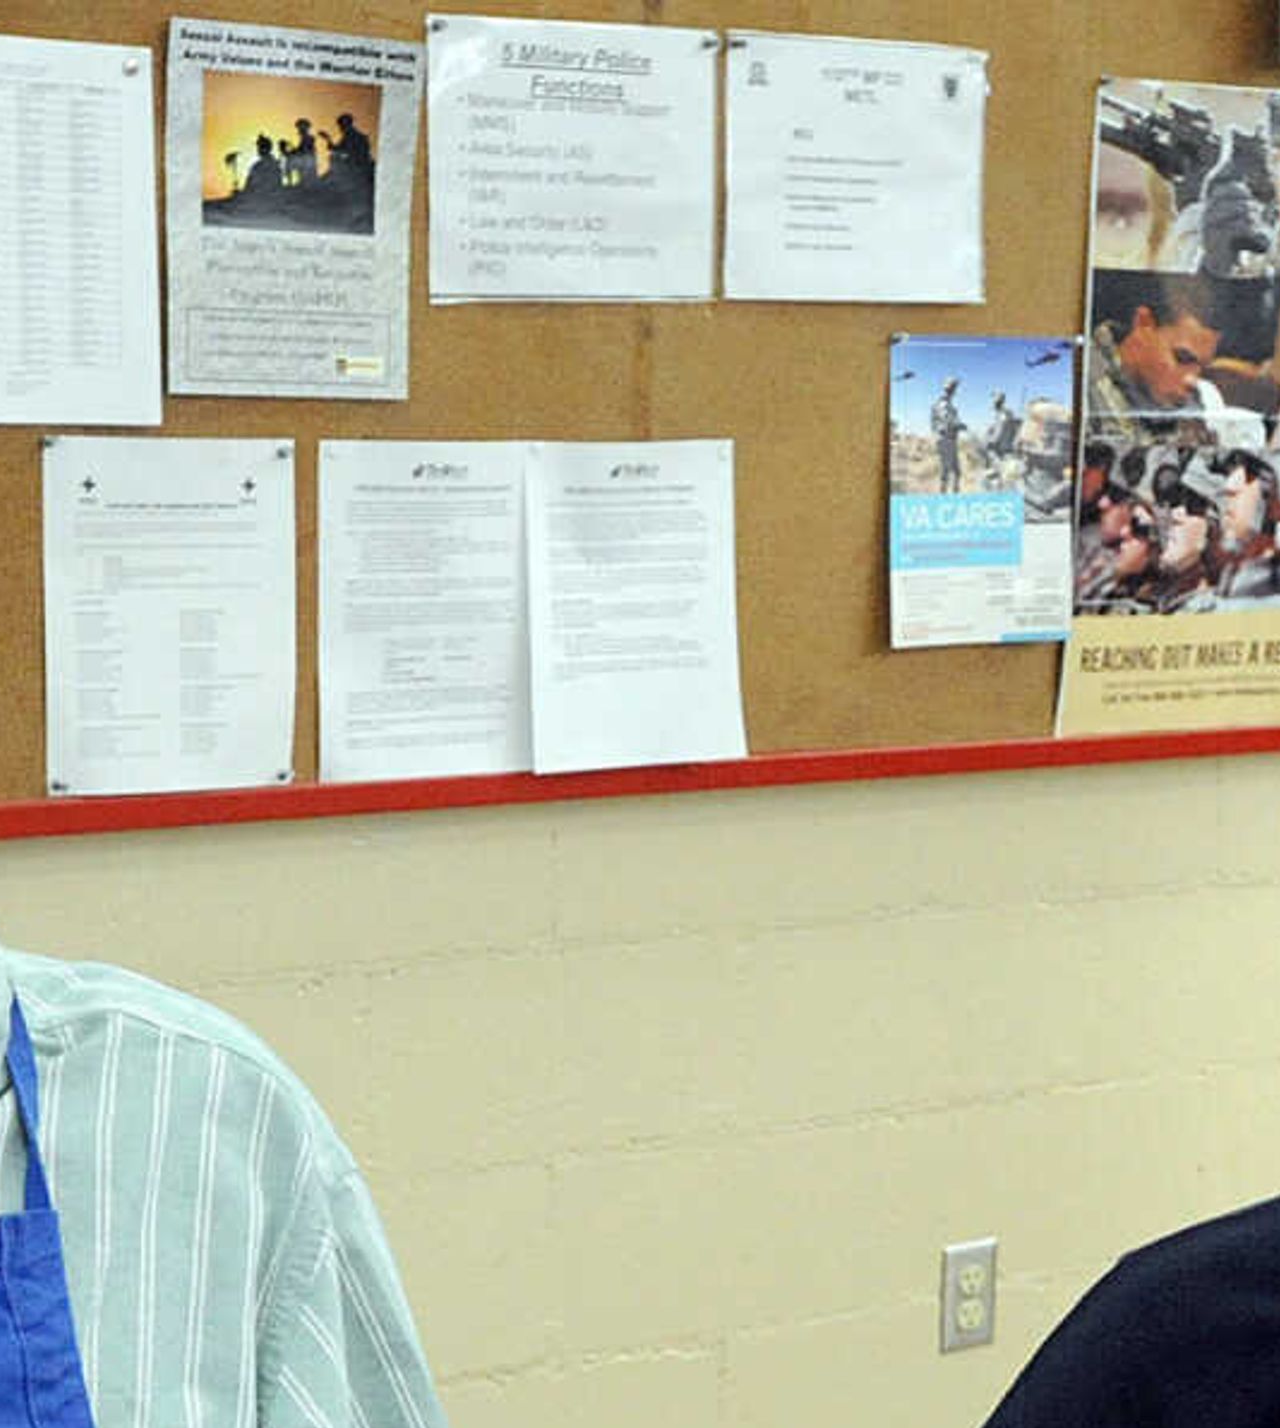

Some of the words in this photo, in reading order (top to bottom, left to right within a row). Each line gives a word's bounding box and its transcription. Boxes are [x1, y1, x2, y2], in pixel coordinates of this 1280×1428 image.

[180, 28, 222, 42] Sexual
[226, 31, 274, 47] Assault
[292, 41, 381, 58] incompatible
[388, 51, 415, 62] with
[503, 43, 513, 61] 5
[519, 44, 589, 67] Military
[593, 49, 651, 68] Police
[184, 50, 216, 63] Army
[220, 52, 261, 66] Values
[267, 58, 288, 68] and
[294, 60, 315, 70] the
[320, 63, 369, 76] Warrior
[531, 75, 623, 97] Functions
[900, 502, 930, 530] VA
[937, 501, 1015, 529] CARES
[1080, 645, 1157, 672] REACHING
[1161, 643, 1193, 669] OUT
[1195, 641, 1246, 667] MAKES
[1248, 640, 1260, 664] A
